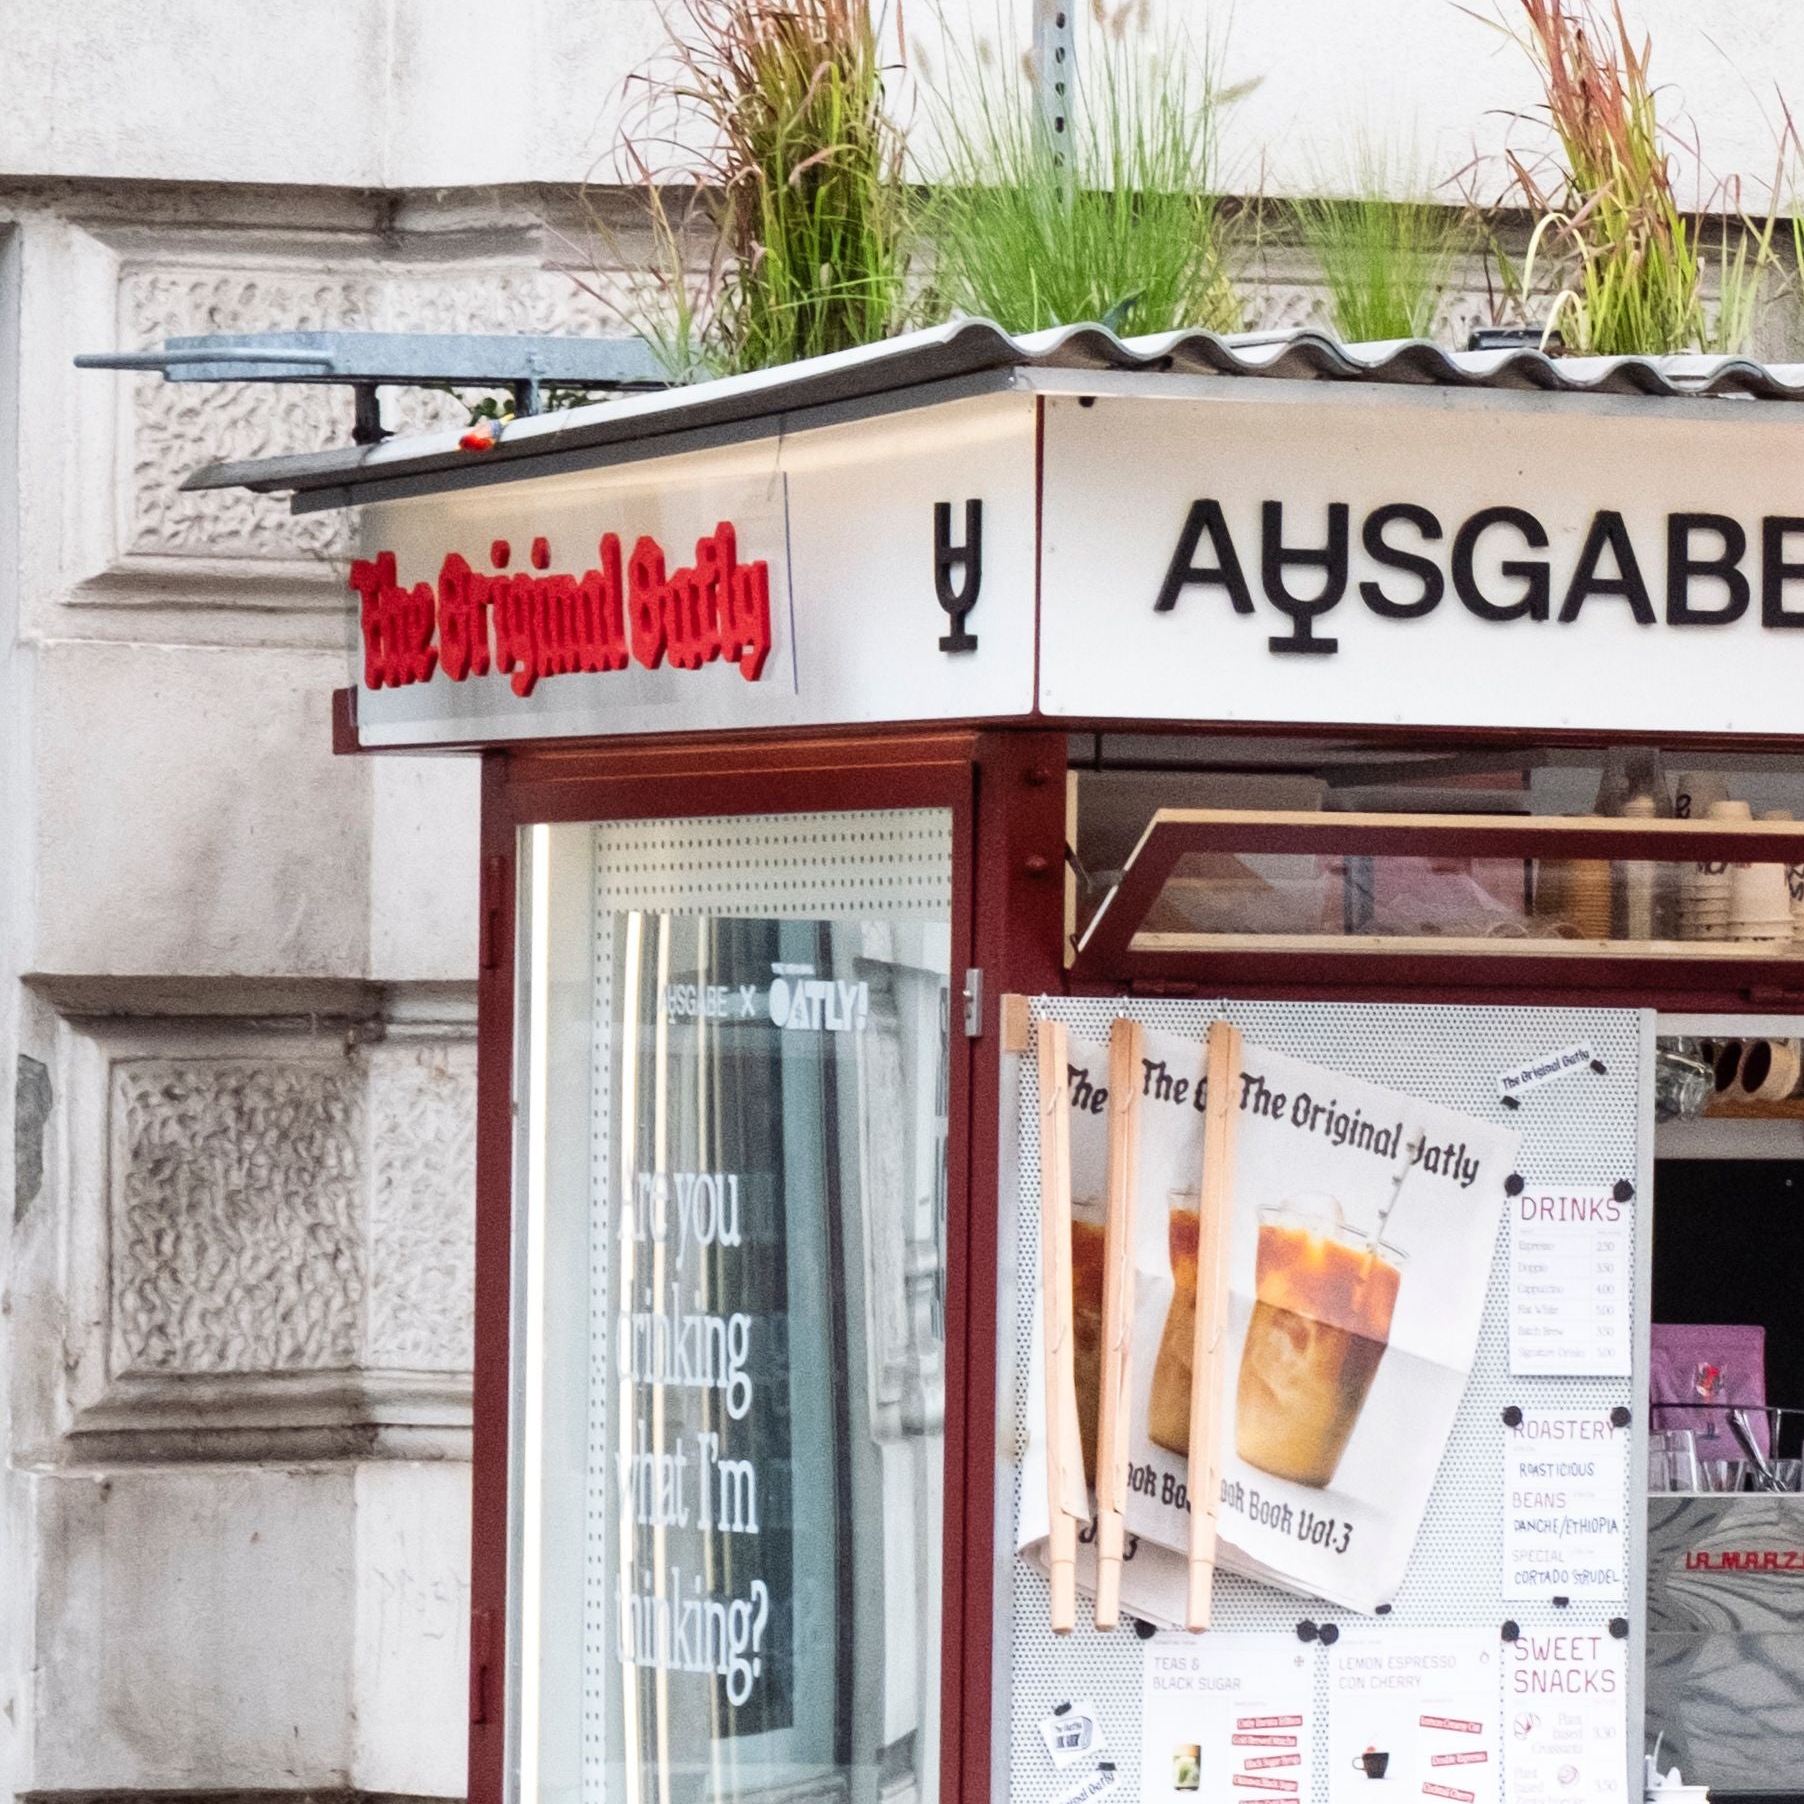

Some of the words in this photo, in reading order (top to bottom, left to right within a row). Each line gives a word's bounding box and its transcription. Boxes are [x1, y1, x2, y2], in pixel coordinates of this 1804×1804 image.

[349, 551, 440, 691] The
[436, 531, 629, 697] Original
[629, 521, 770, 683] Oatly
[768, 978, 869, 1031] OATLY!
[1067, 1064, 1109, 1115] The
[1141, 1058, 1189, 1103] The
[1239, 1072, 1285, 1120] The
[1290, 1092, 1404, 1161] Original
[676, 1173, 742, 1269] you
[1520, 1196, 1622, 1222] DRINKS
[615, 1283, 753, 1420] drinking
[1512, 1420, 1617, 1440] ROASTERY
[1512, 1492, 1567, 1508] BEANS
[1249, 1491, 1294, 1536] Book
[1511, 1549, 1565, 1563] SPECIAL
[1686, 1550, 1718, 1571] LA
[1513, 1636, 1602, 1661] SWEET
[1153, 1657, 1187, 1671] TEAS
[1338, 1657, 1382, 1671] LEMON
[1387, 1655, 1457, 1670] ESPRESSO
[1152, 1676, 1194, 1690] BLACK
[1199, 1677, 1241, 1691] SUGAR
[1338, 1676, 1366, 1689] CON
[1369, 1676, 1421, 1689] CHERRY
[1513, 1669, 1616, 1693] SNACKS
